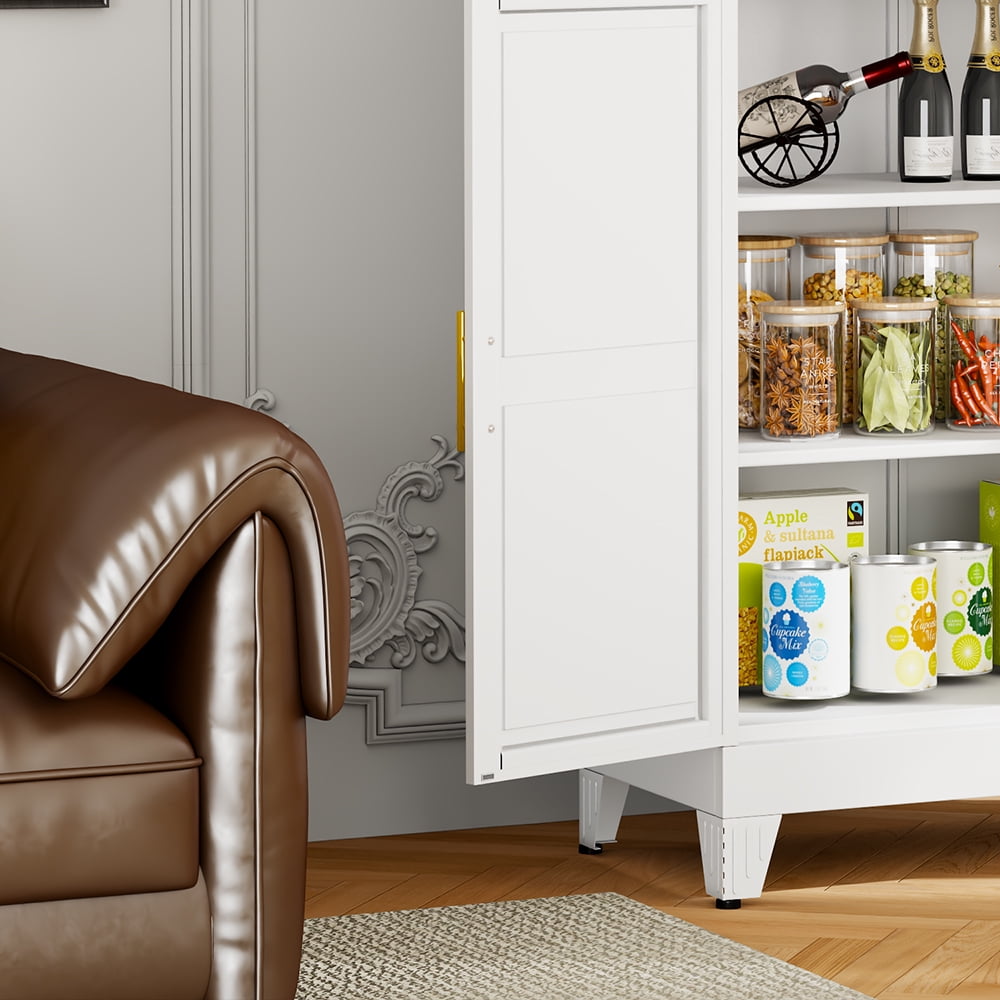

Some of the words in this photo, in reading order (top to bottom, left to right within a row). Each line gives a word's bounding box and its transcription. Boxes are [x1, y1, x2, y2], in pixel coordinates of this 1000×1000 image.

[803, 357, 832, 367] STAR
[800, 368, 835, 378] ANISE
[763, 509, 808, 527] Apple
[763, 529, 776, 543] &
[780, 528, 835, 542] sultana
[763, 545, 824, 561] flapjack
[770, 624, 806, 640] Cupcake
[779, 637, 803, 650] Mix
